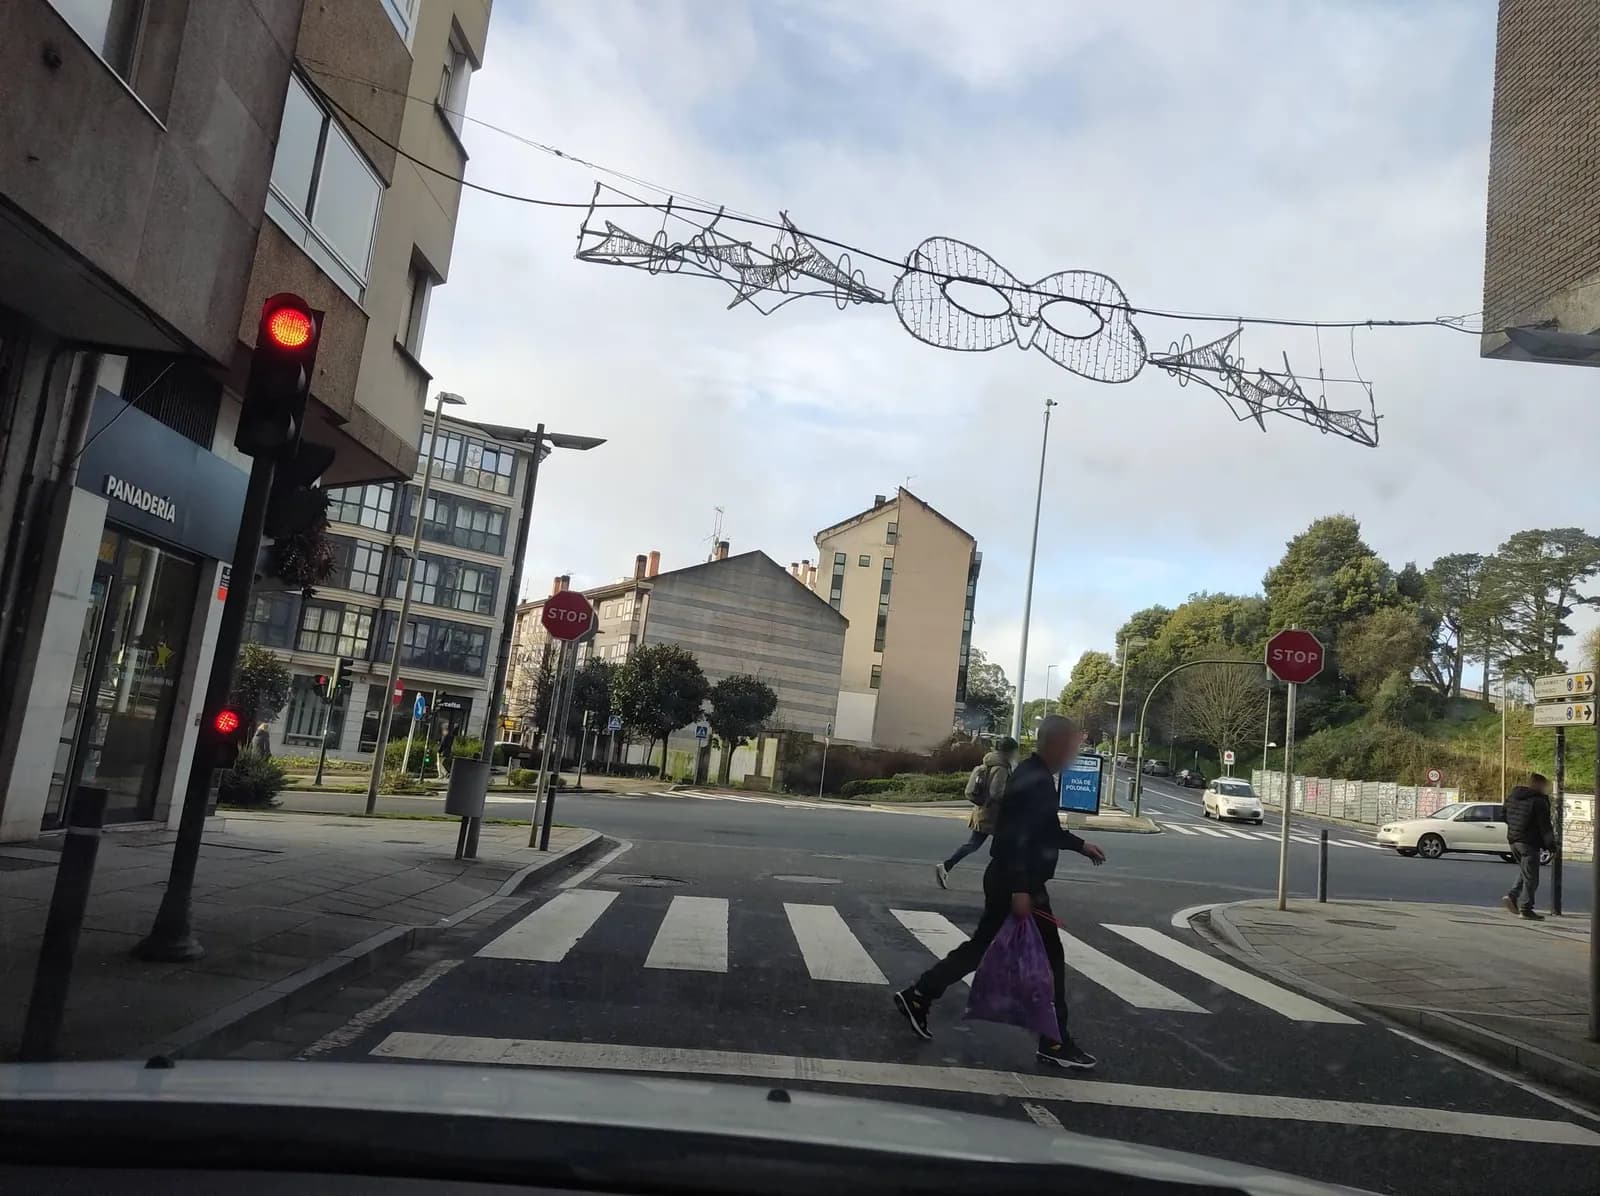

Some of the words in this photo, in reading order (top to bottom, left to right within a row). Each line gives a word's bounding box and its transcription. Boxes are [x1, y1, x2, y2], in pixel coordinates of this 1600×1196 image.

[106, 475, 176, 523] PANADERÍA
[547, 607, 588, 623] STOP
[1271, 648, 1318, 664] STOP
